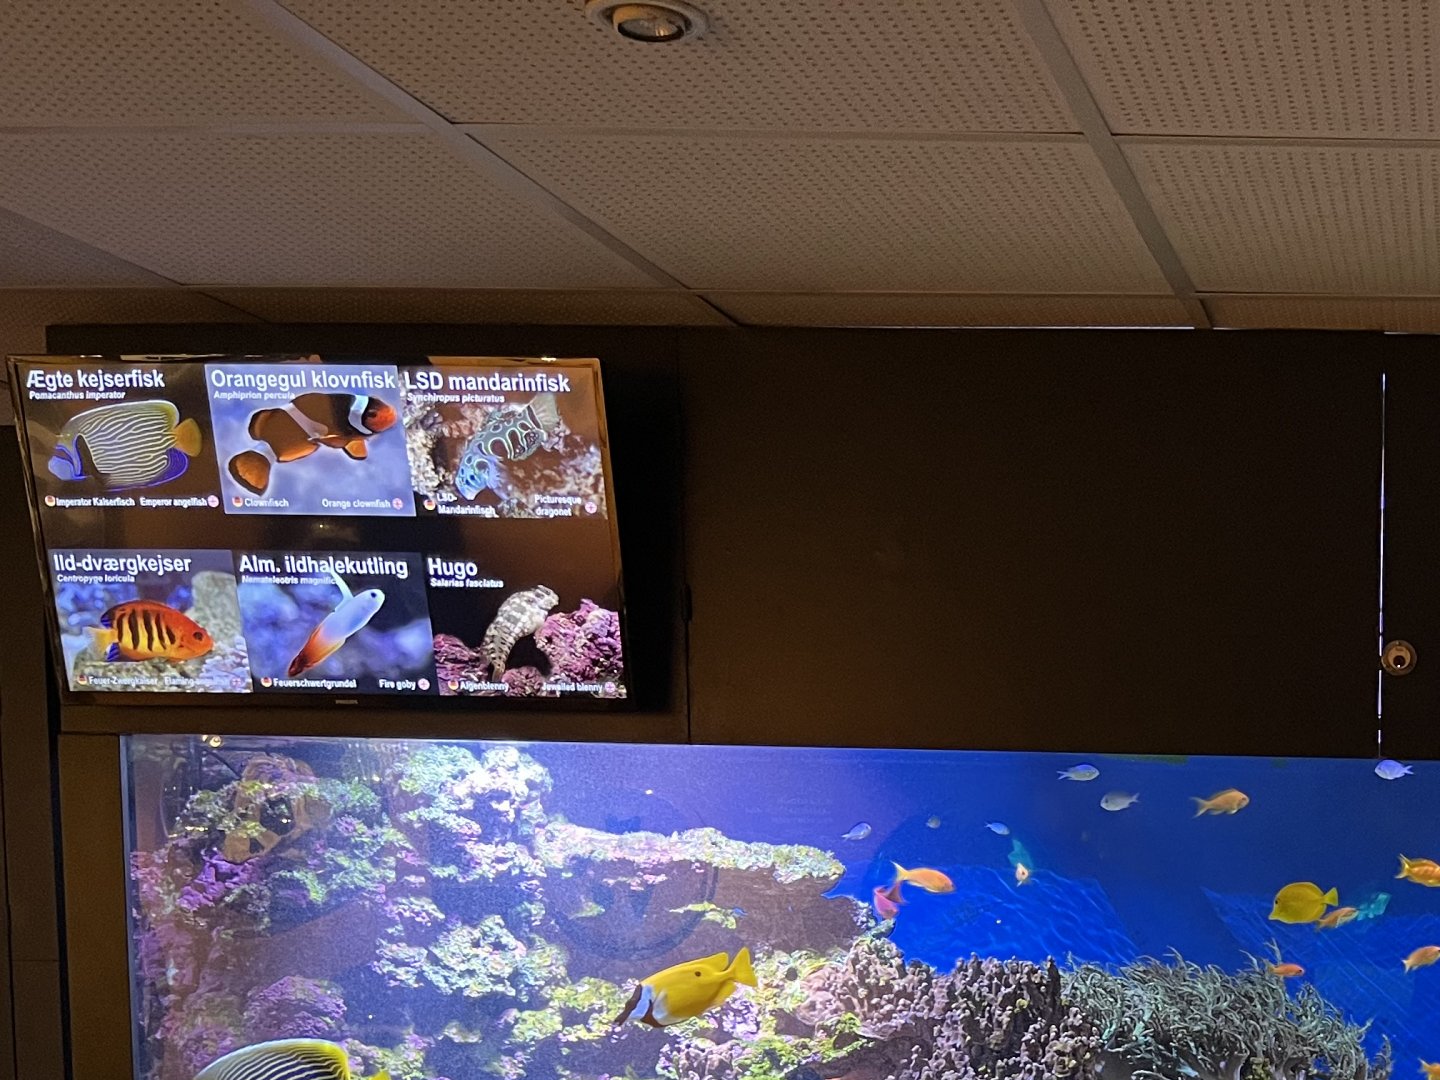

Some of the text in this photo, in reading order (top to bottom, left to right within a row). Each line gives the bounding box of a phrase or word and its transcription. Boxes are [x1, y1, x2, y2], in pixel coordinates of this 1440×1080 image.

[27, 370, 165, 391] Ægte kejserfisk
[211, 370, 396, 391] Orangegul klovnfisk
[405, 371, 570, 392] LSD mandarinfisk
[29, 391, 84, 399] Pomacanthus
[214, 391, 261, 400] Amphiprion
[140, 498, 171, 507] Emperor
[245, 498, 289, 507] Clownfisch
[322, 498, 350, 509] Orange
[54, 554, 191, 575] Ild-dværgkejser
[240, 555, 408, 579] Alm. ildhalekutling
[428, 558, 478, 579] Hugo
[379, 679, 416, 690] Fire goby
